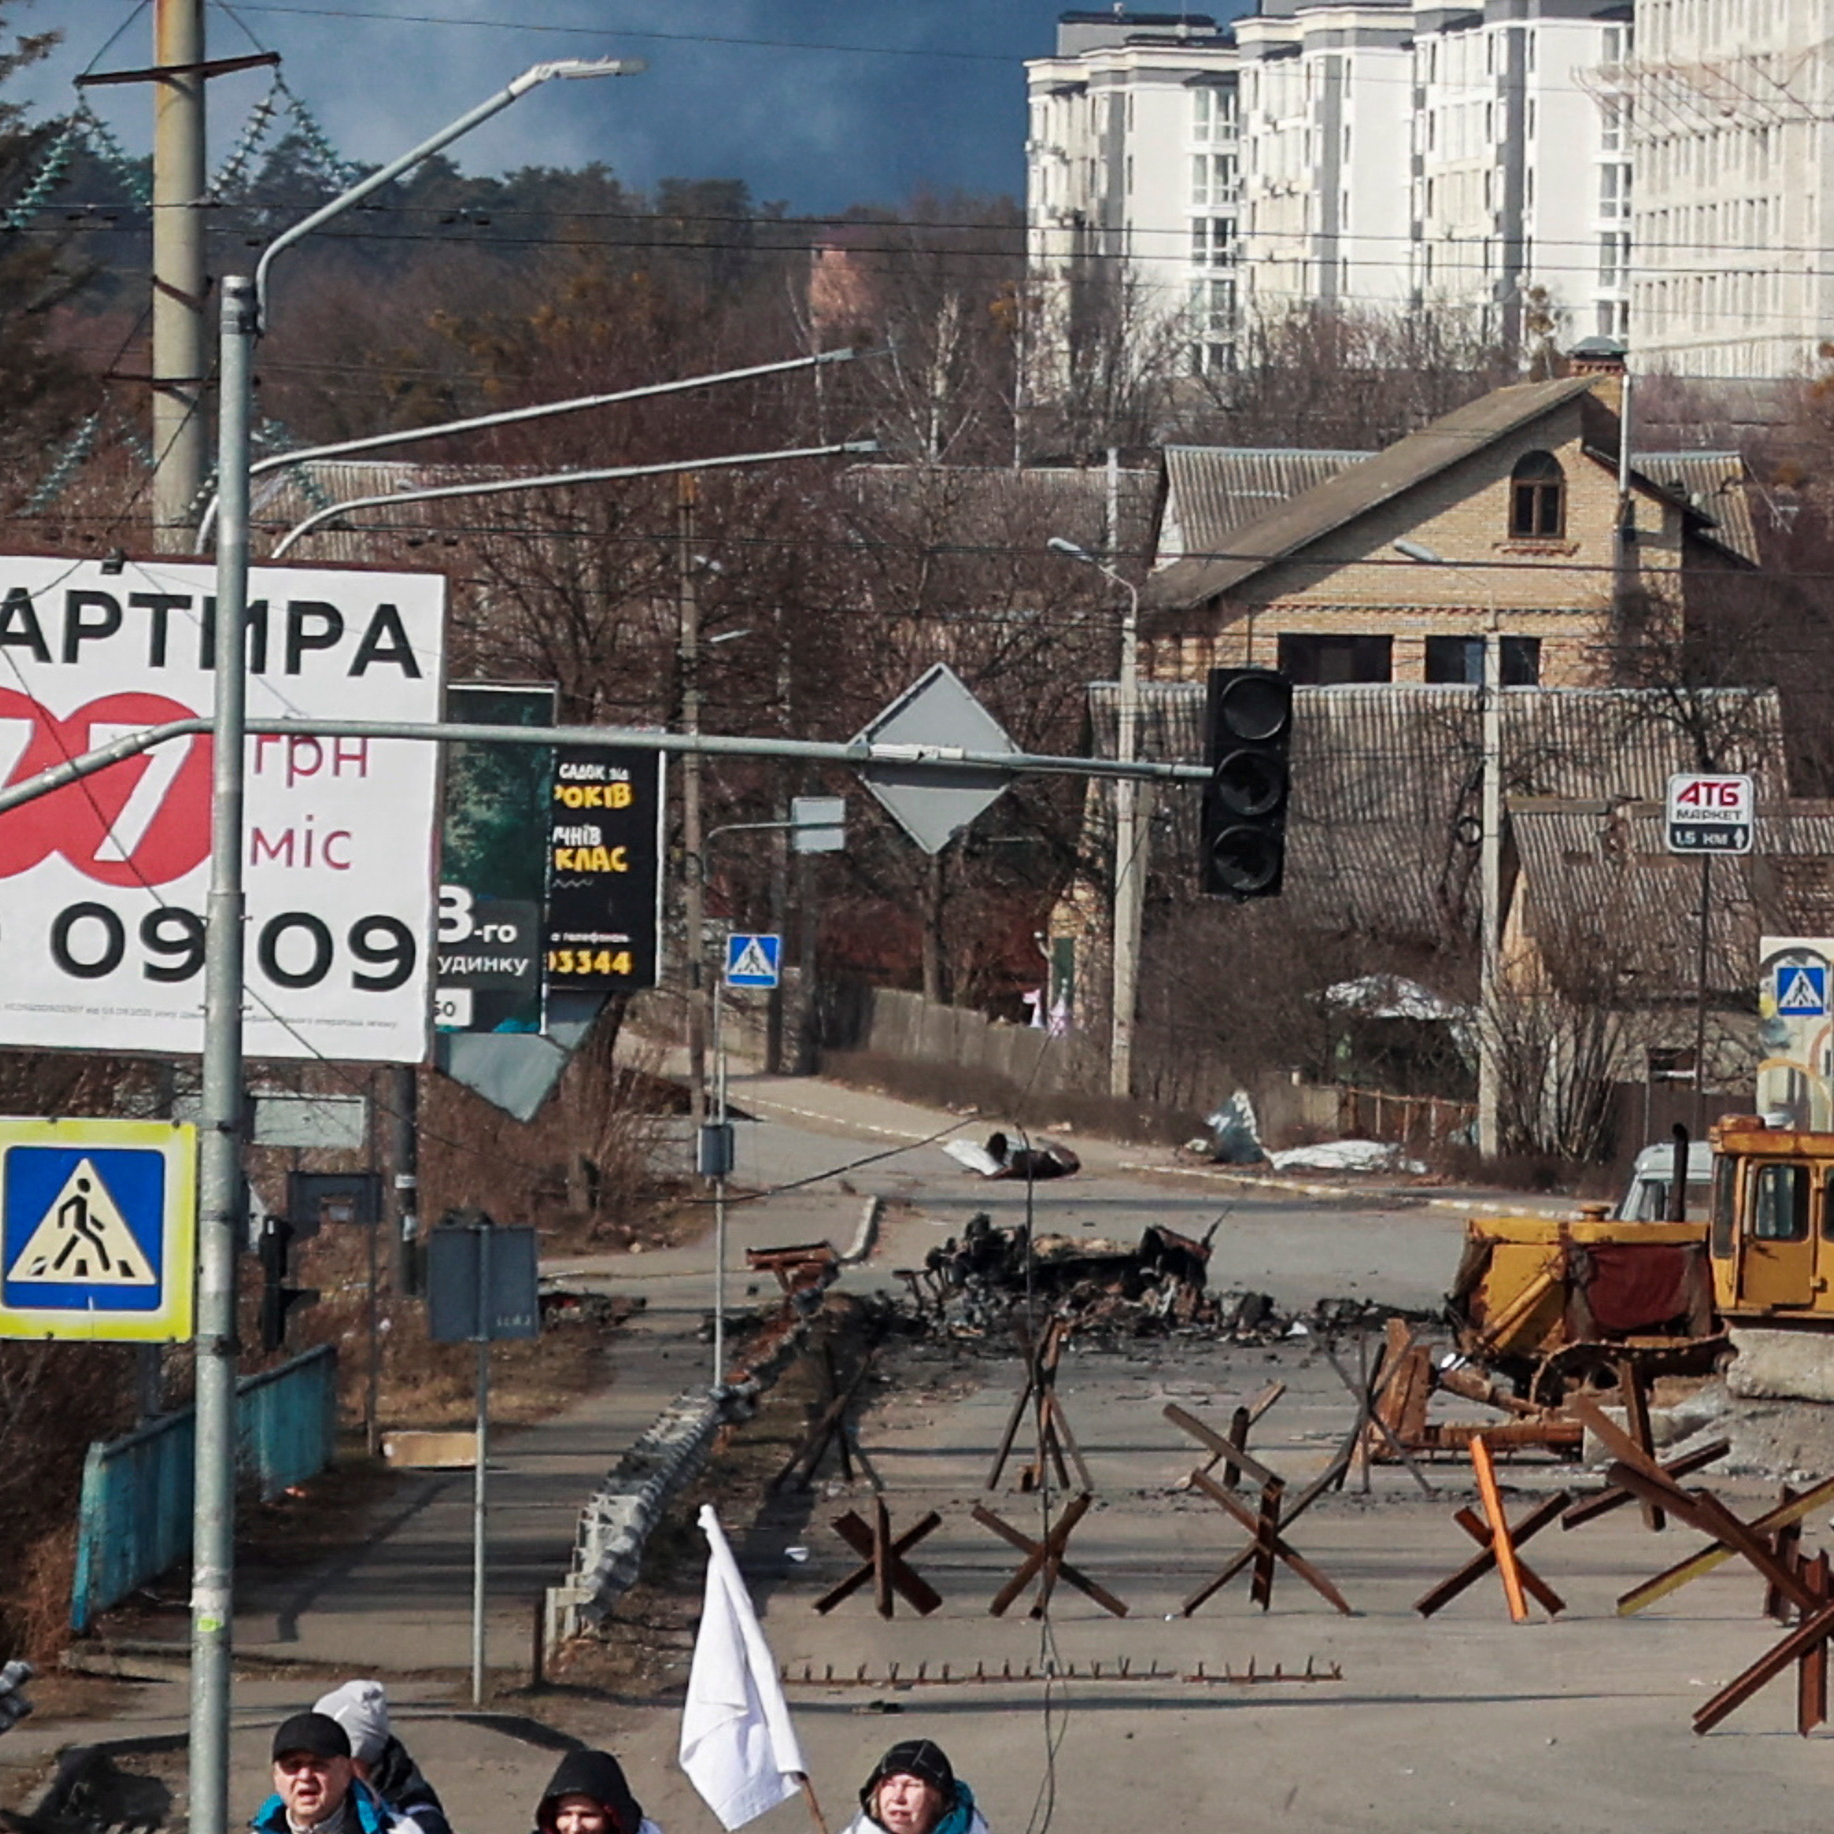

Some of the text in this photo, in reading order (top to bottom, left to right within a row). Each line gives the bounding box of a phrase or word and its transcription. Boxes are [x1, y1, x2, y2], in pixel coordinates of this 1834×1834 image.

[253, 735, 369, 793] грн
[558, 762, 606, 781] САДОК
[1676, 780, 1742, 807] АТБ
[1676, 809, 1743, 821] МАРКЕТ
[250, 816, 353, 871] міс
[554, 845, 629, 872] КЛАС
